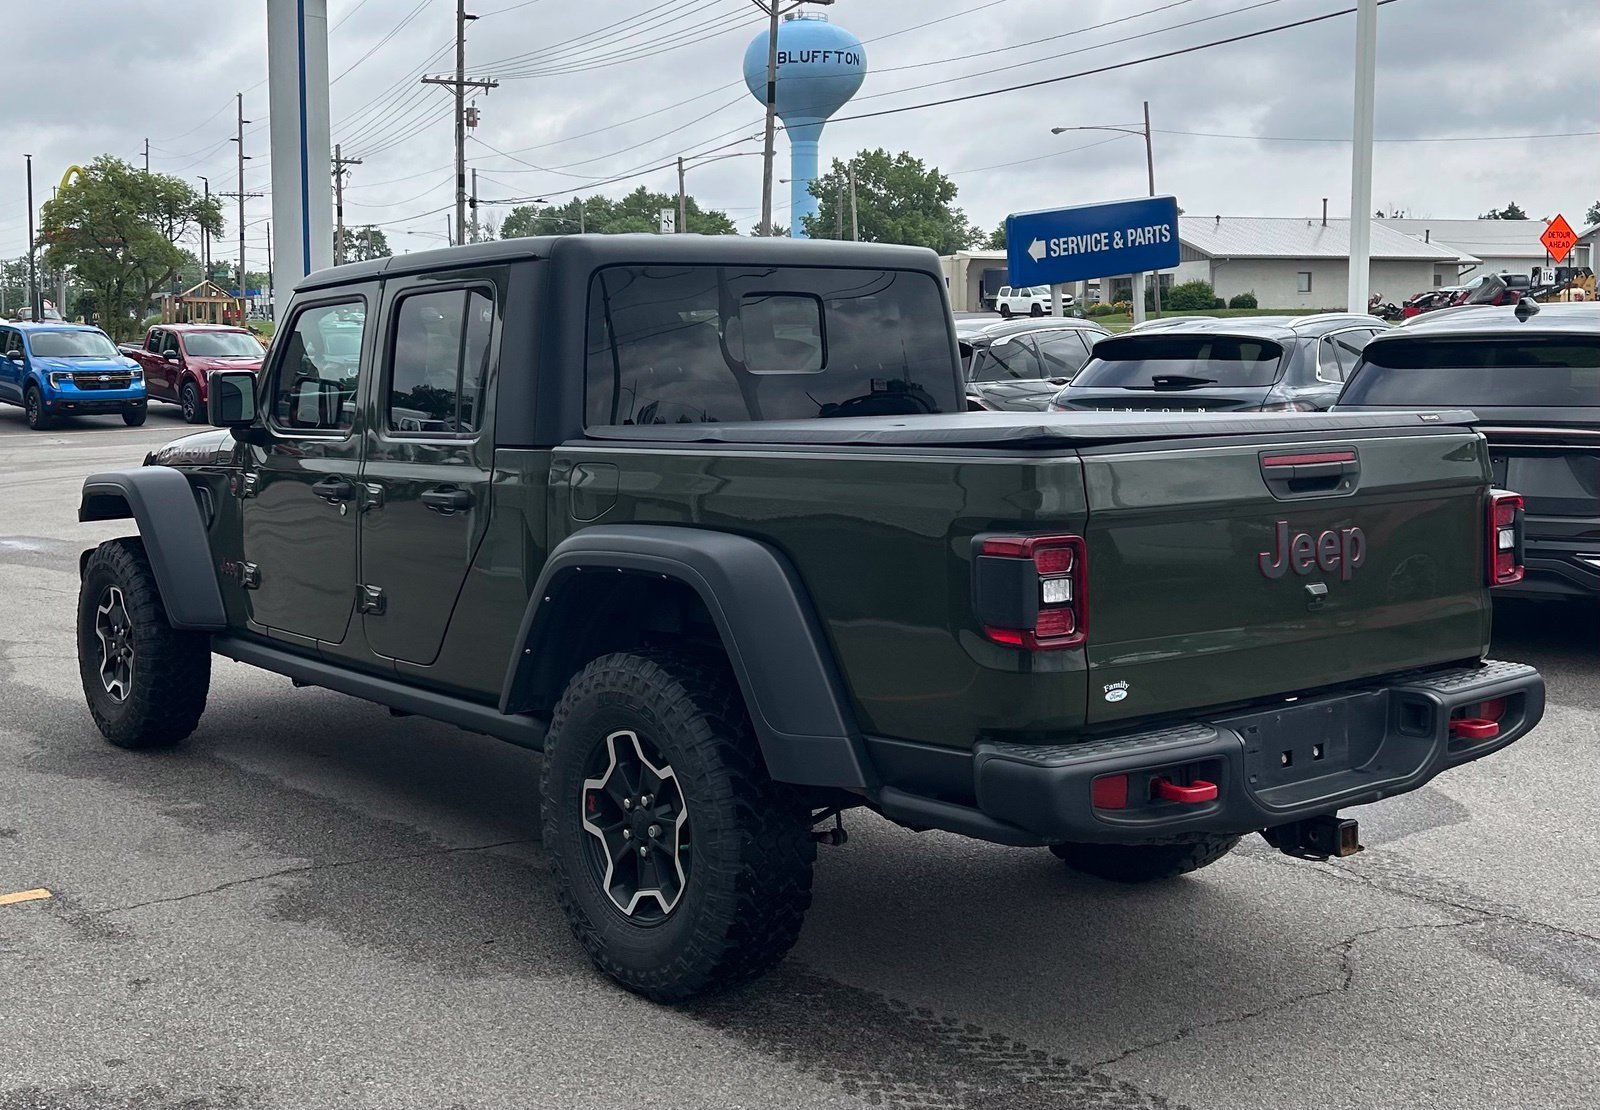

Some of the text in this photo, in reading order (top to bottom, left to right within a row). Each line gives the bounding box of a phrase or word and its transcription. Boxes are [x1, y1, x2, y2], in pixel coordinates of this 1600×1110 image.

[777, 50, 860, 66] BLUFFTON
[1050, 223, 1171, 258] SERVICE & PARTS
[1548, 231, 1571, 239] DETOUR
[1548, 241, 1570, 249] AHEAD
[1258, 520, 1367, 581] Jeep
[1103, 680, 1130, 693] Family
